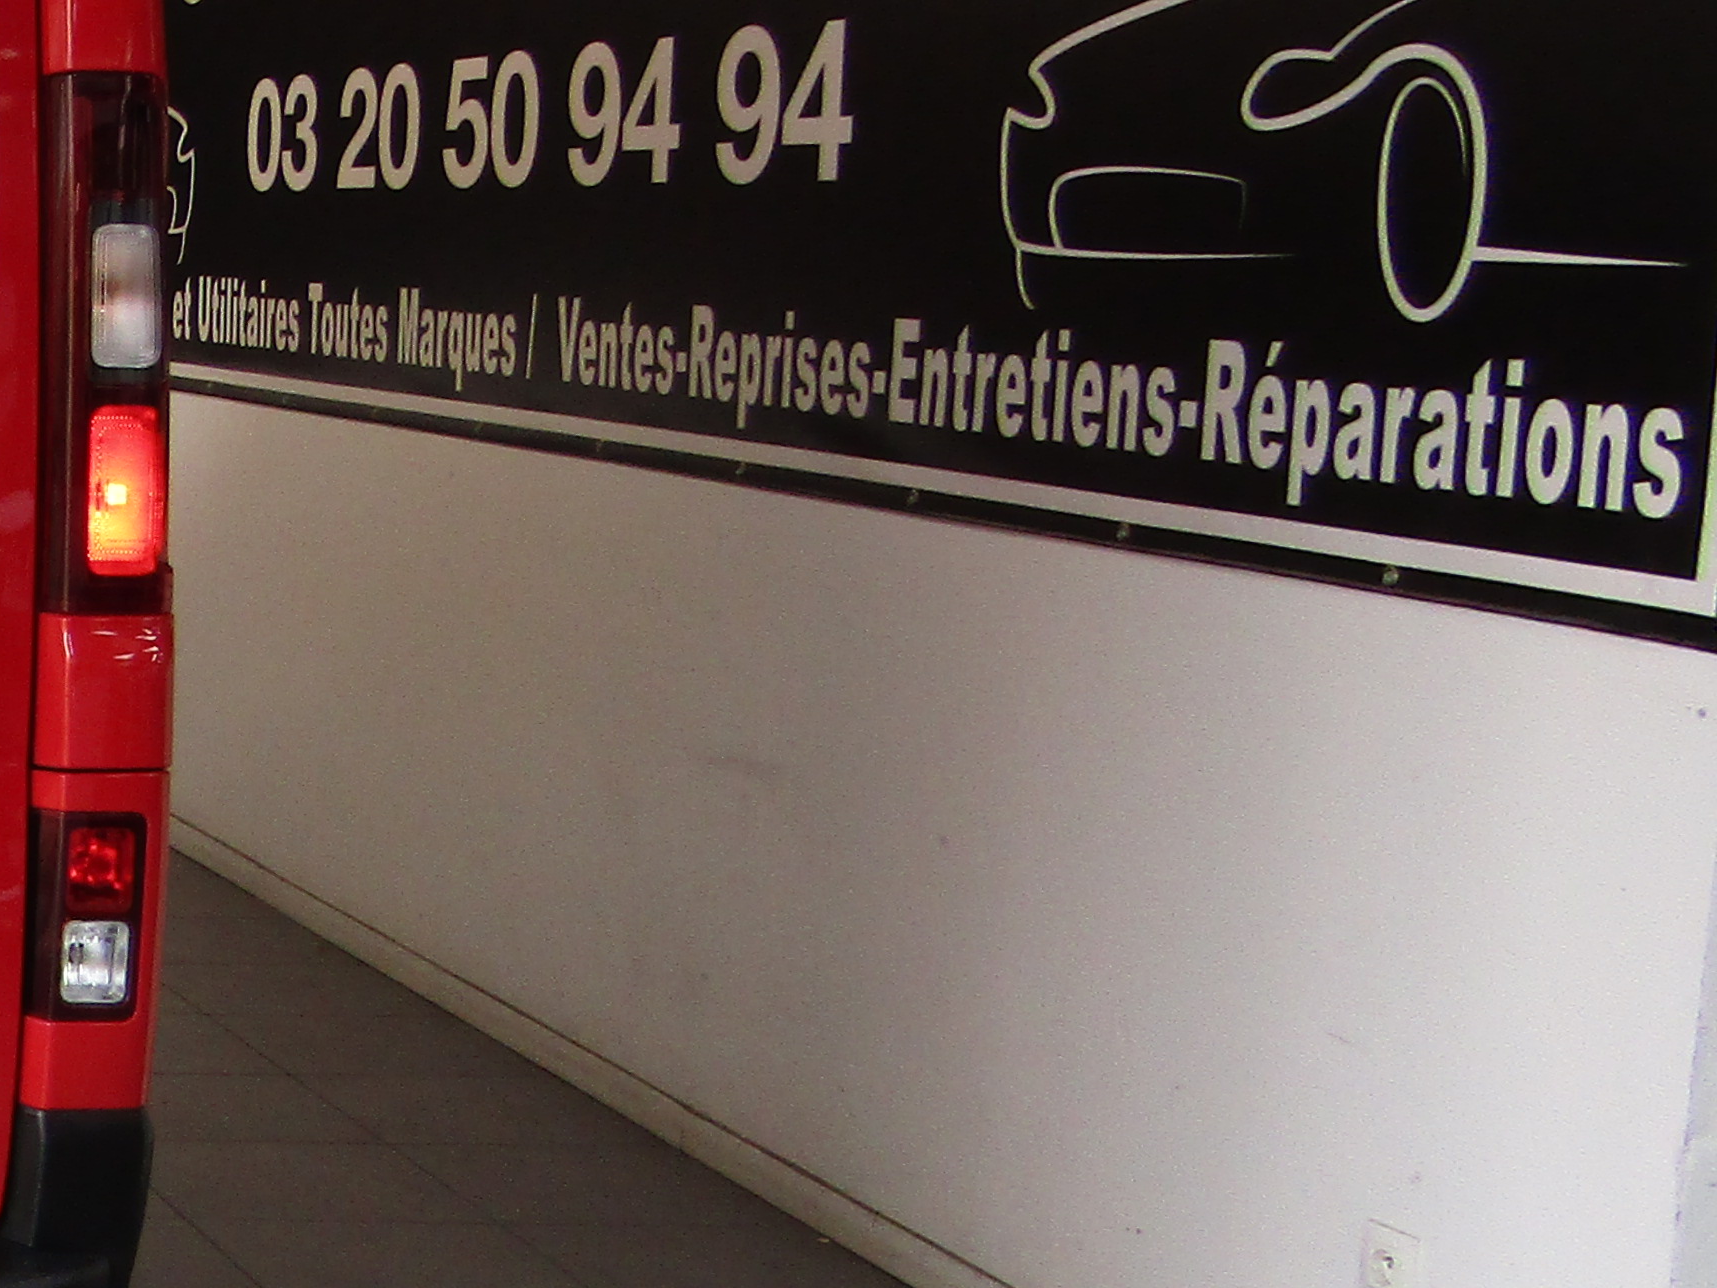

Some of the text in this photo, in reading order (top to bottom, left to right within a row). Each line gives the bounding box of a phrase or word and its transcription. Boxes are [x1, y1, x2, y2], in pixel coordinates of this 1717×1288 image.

[247, 19, 854, 192] 03 20 50 94 94
[171, 276, 192, 339] et
[198, 274, 300, 354] Utilitaires
[308, 282, 388, 364] Toutes
[396, 286, 516, 391] Marques
[524, 292, 539, 380] /
